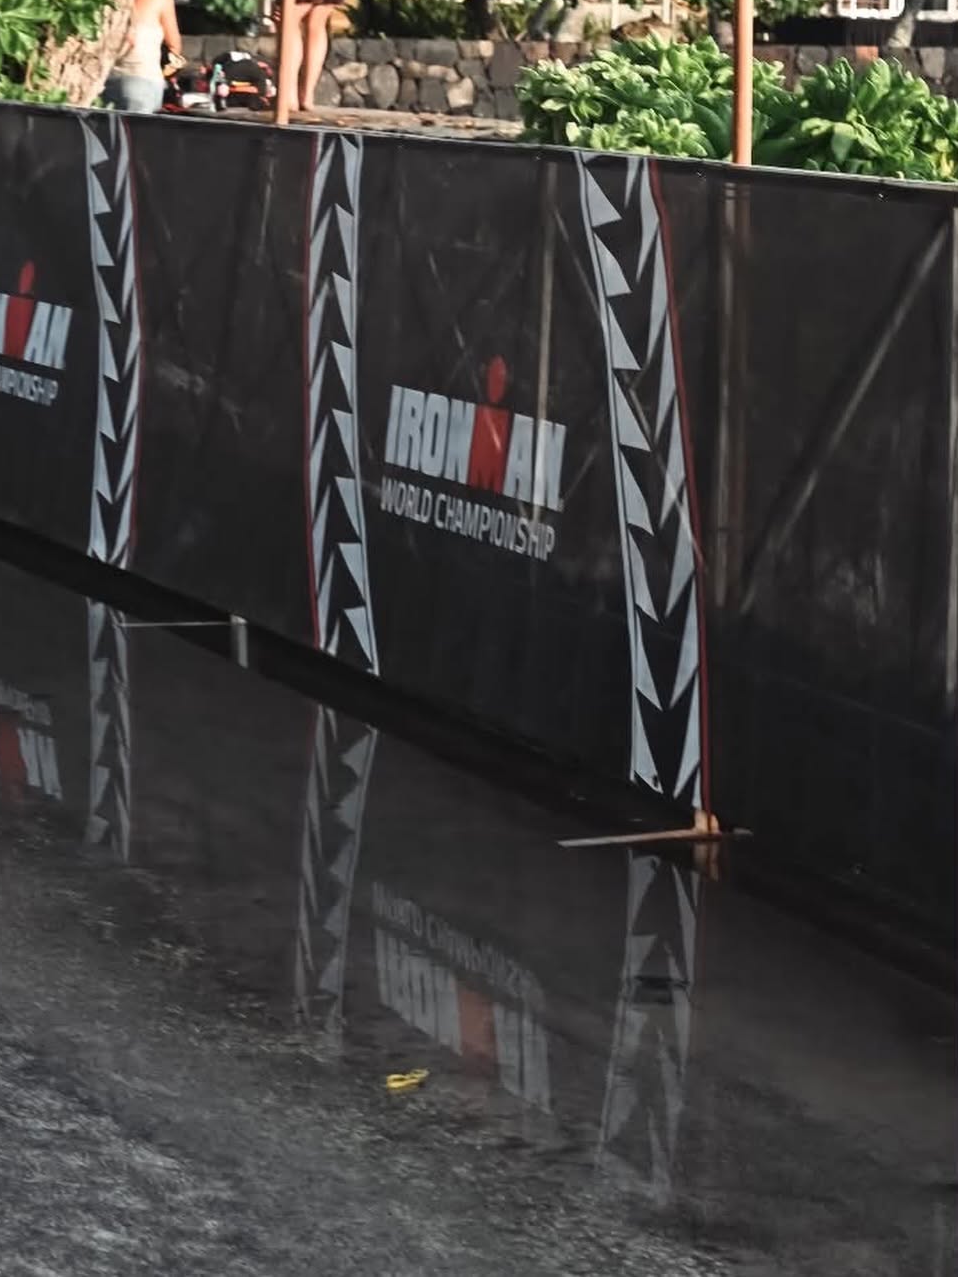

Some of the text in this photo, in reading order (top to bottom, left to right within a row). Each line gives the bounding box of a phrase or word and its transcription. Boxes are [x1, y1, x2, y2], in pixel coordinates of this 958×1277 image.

[384, 356, 567, 512] IRONMAN
[380, 474, 555, 562] WORLD CHAMPIONSHIP
